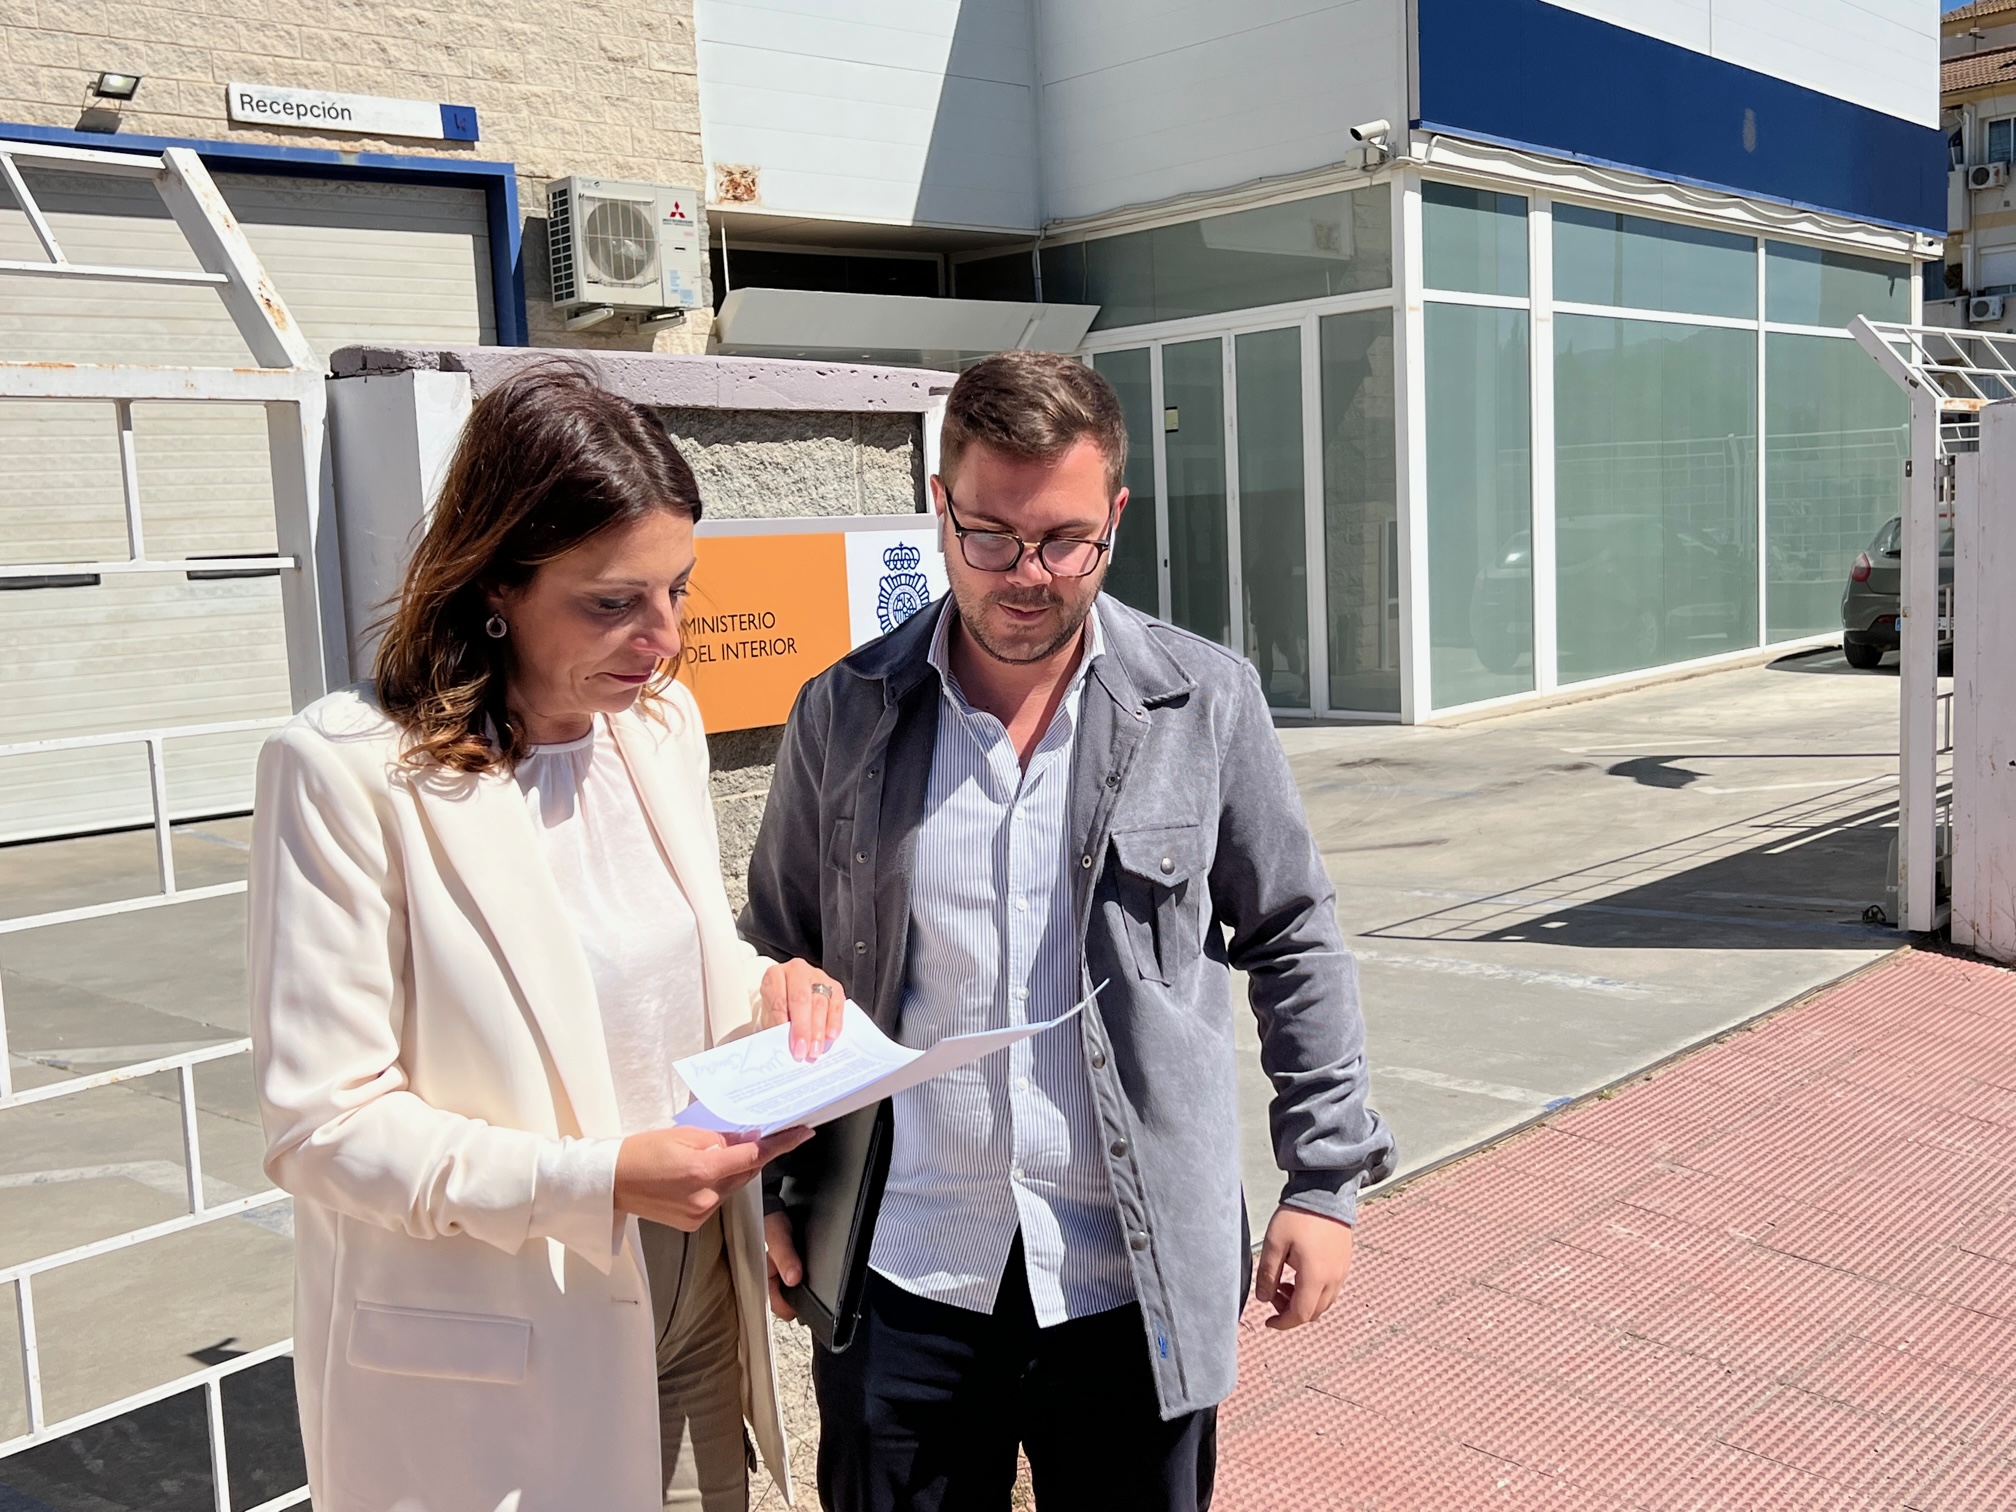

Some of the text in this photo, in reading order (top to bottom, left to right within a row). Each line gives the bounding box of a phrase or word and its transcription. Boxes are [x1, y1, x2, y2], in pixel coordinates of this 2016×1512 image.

[240, 93, 352, 121] Recepción
[684, 611, 776, 635] MINISTERIO
[685, 637, 798, 664] DEL INTERIOR
